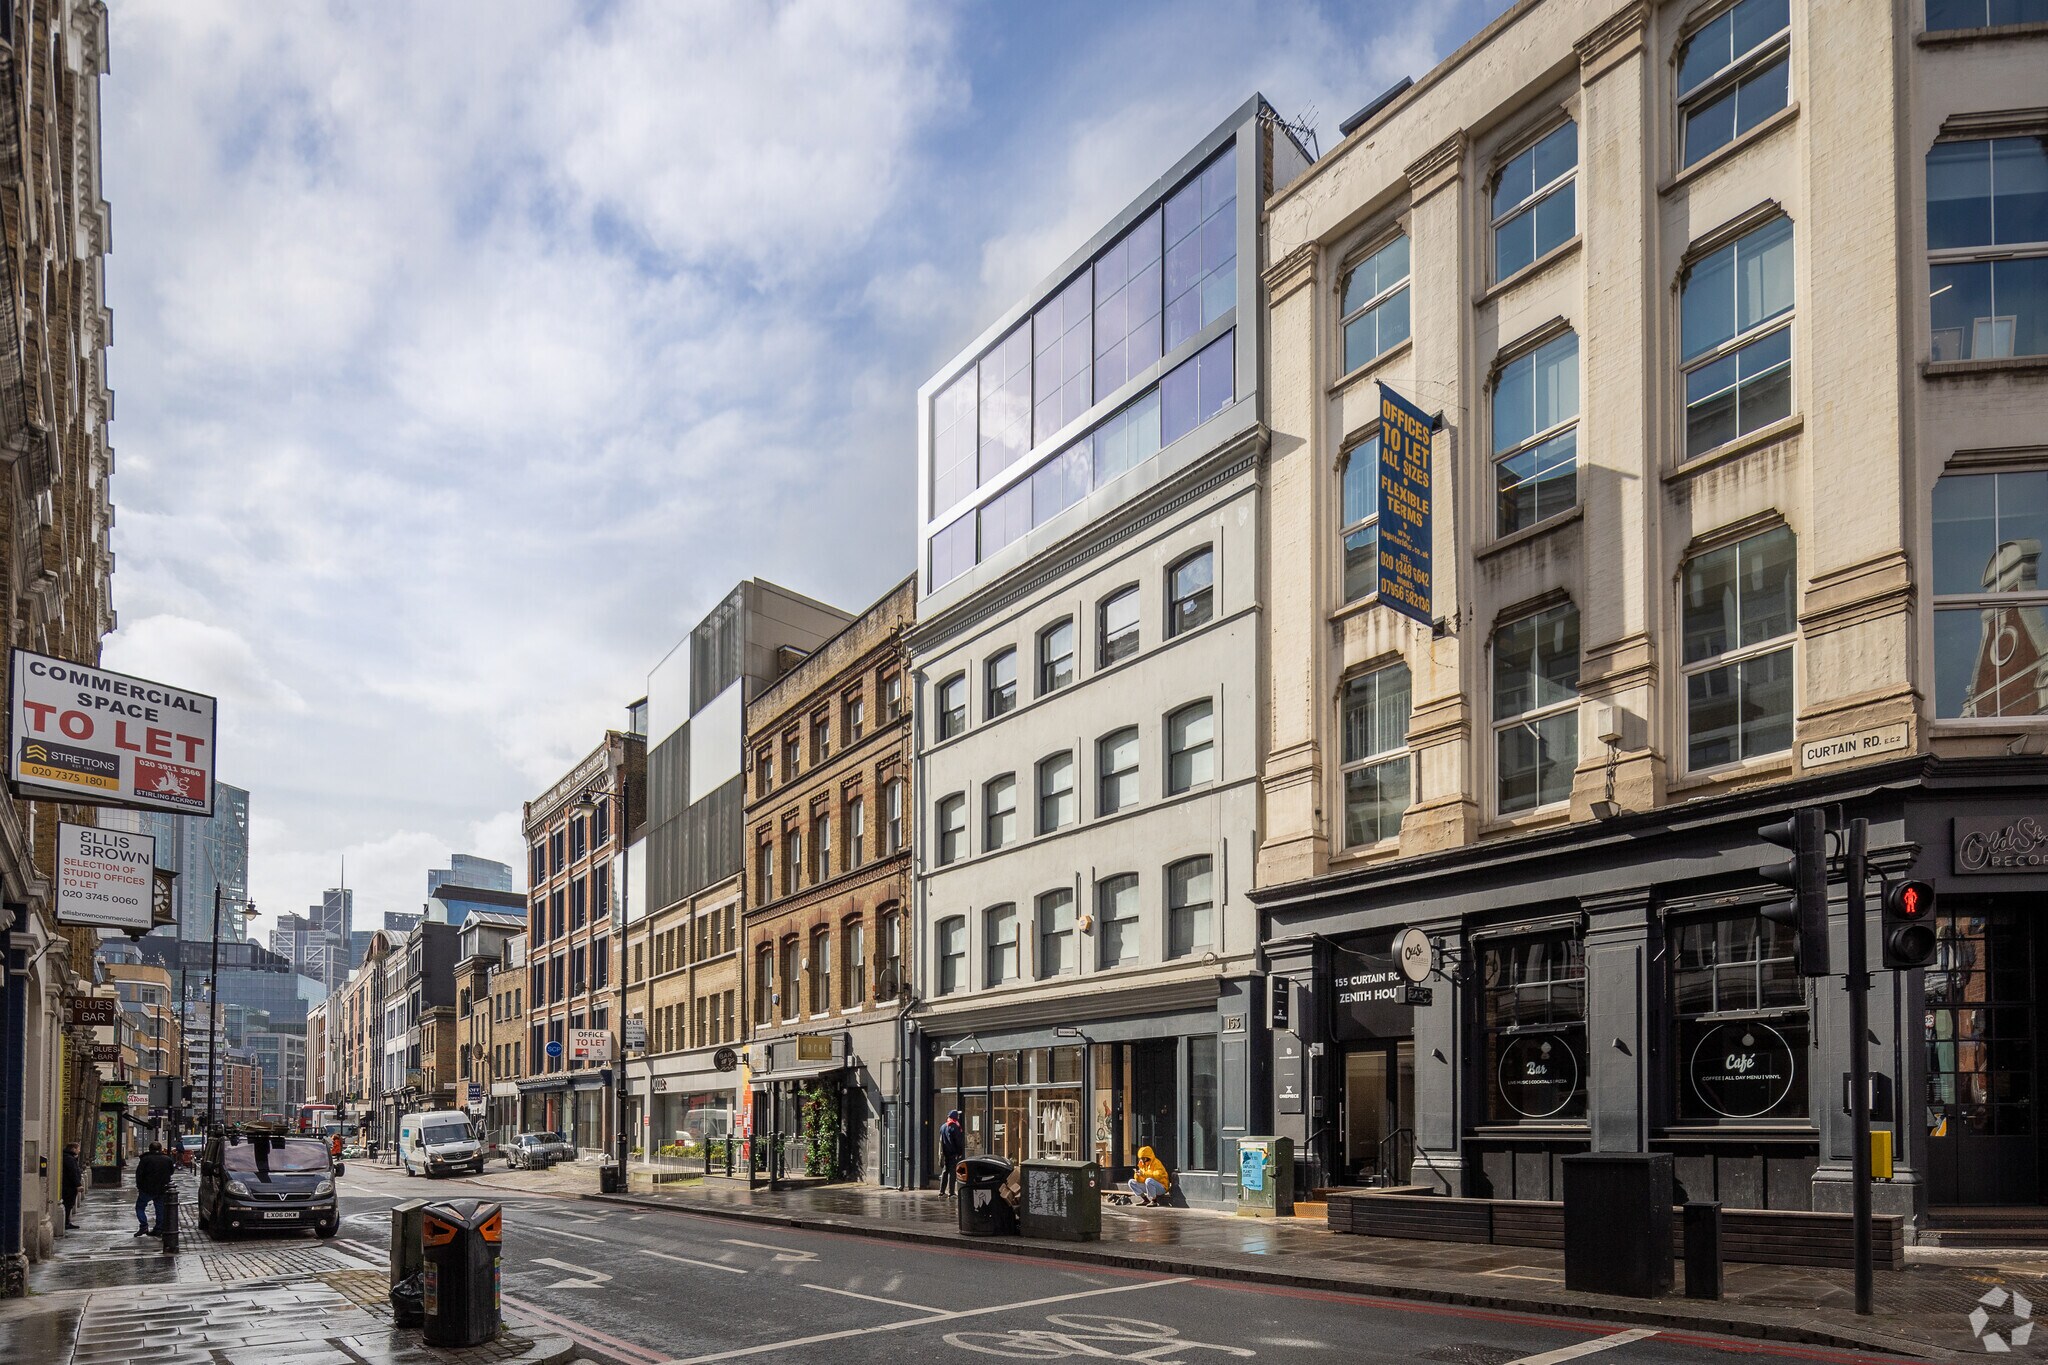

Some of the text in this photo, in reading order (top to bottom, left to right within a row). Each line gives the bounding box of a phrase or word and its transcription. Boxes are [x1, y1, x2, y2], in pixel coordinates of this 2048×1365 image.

[1382, 399, 1430, 446] OFFICES
[1382, 421, 1430, 469] TO LET
[1381, 446, 1430, 488] ALL SIZES
[1381, 474, 1430, 515] FLEXIBLE
[1387, 495, 1423, 528] TERMS
[1380, 551, 1394, 571] 020
[29, 661, 202, 714] COMMERCIAL
[77, 692, 159, 723] SPACE
[24, 700, 205, 763] TO LET
[1807, 740, 1857, 760] CURTAIN
[1863, 735, 1881, 749] RD.
[51, 751, 115, 771] STRETTONS
[139, 760, 155, 768] 020
[32, 766, 107, 787] 020 7375 1801
[136, 790, 203, 806] STIRLING ACKROYD
[80, 831, 130, 849] ELLIS
[80, 844, 149, 865] BROWN
[63, 857, 136, 874] SELECTION OF
[63, 868, 145, 886] STUDIO OFFICES
[63, 878, 98, 889] TO LET
[62, 889, 138, 906] 020 3745 0060
[61, 909, 149, 924] ellisbrowncommercial.com
[1335, 971, 1400, 987] 155 CURTAIN RO
[1339, 987, 1397, 1004] ZENITH HOU
[81, 1012, 106, 1022] BAR
[590, 1039, 606, 1047] LET
[1526, 1061, 1548, 1075] Bar
[1725, 1053, 1756, 1073] Café
